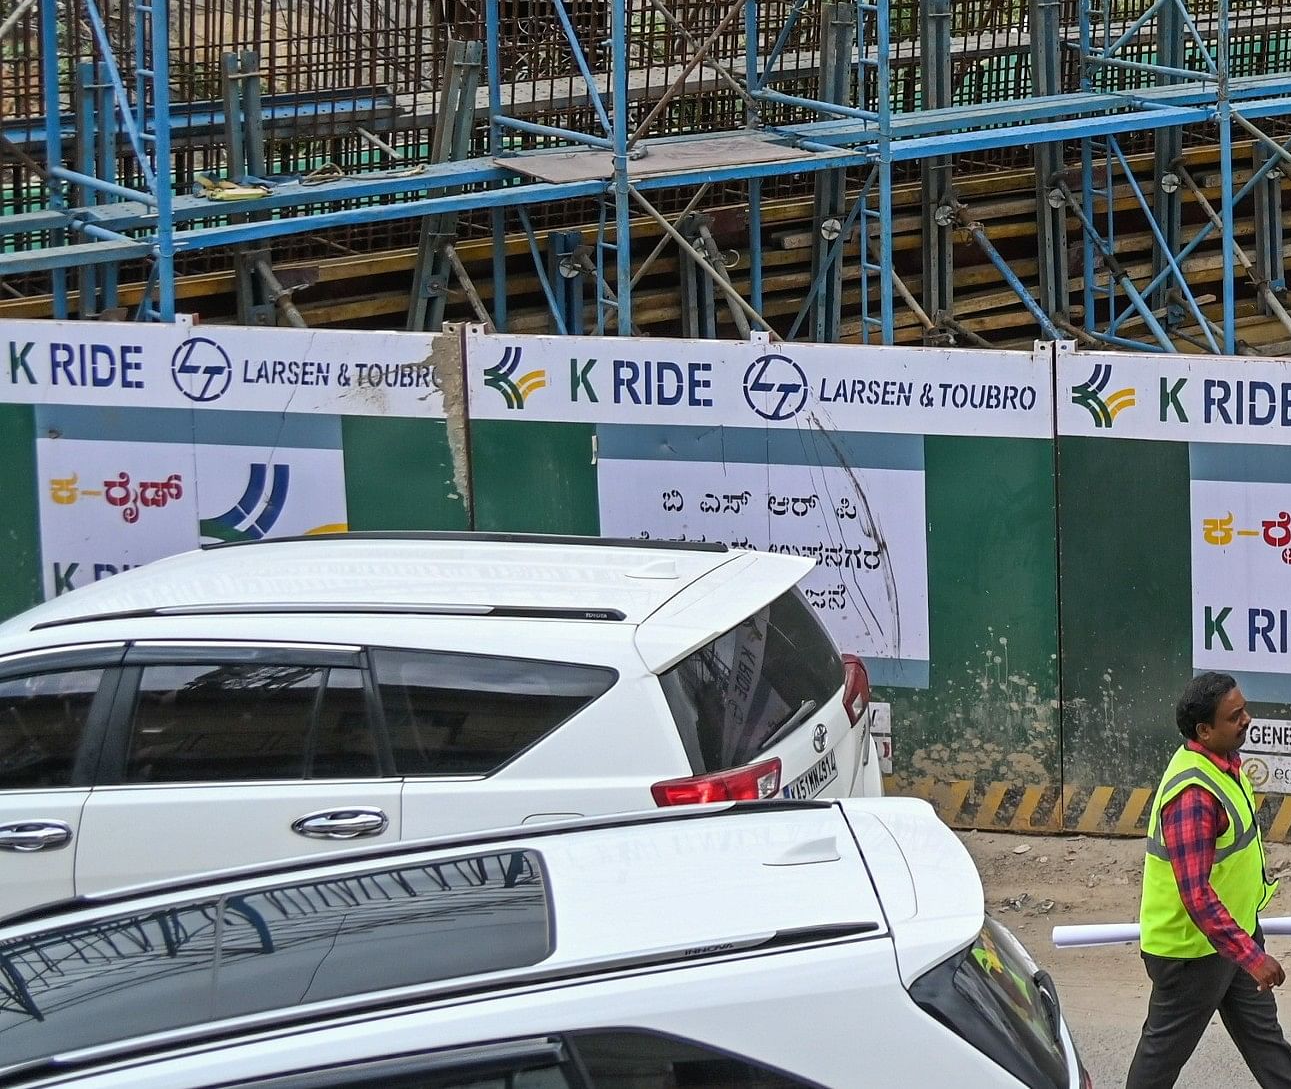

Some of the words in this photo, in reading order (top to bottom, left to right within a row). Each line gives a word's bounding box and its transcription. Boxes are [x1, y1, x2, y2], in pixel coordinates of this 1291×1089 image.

[10, 342, 37, 384] K
[50, 343, 144, 388] RIDE
[243, 360, 330, 385] LARSEN
[338, 363, 350, 387] &
[571, 359, 599, 402] K
[613, 360, 712, 406] RIDE
[820, 378, 913, 406] LARSEN
[920, 383, 933, 407] &
[939, 384, 1036, 410] TOUBRO
[1160, 377, 1188, 423] K
[663, 490, 683, 511] ಬಿ
[700, 491, 751, 513] ಎಸ್
[837, 498, 856, 519] ಪಿ
[1205, 606, 1233, 651] K
